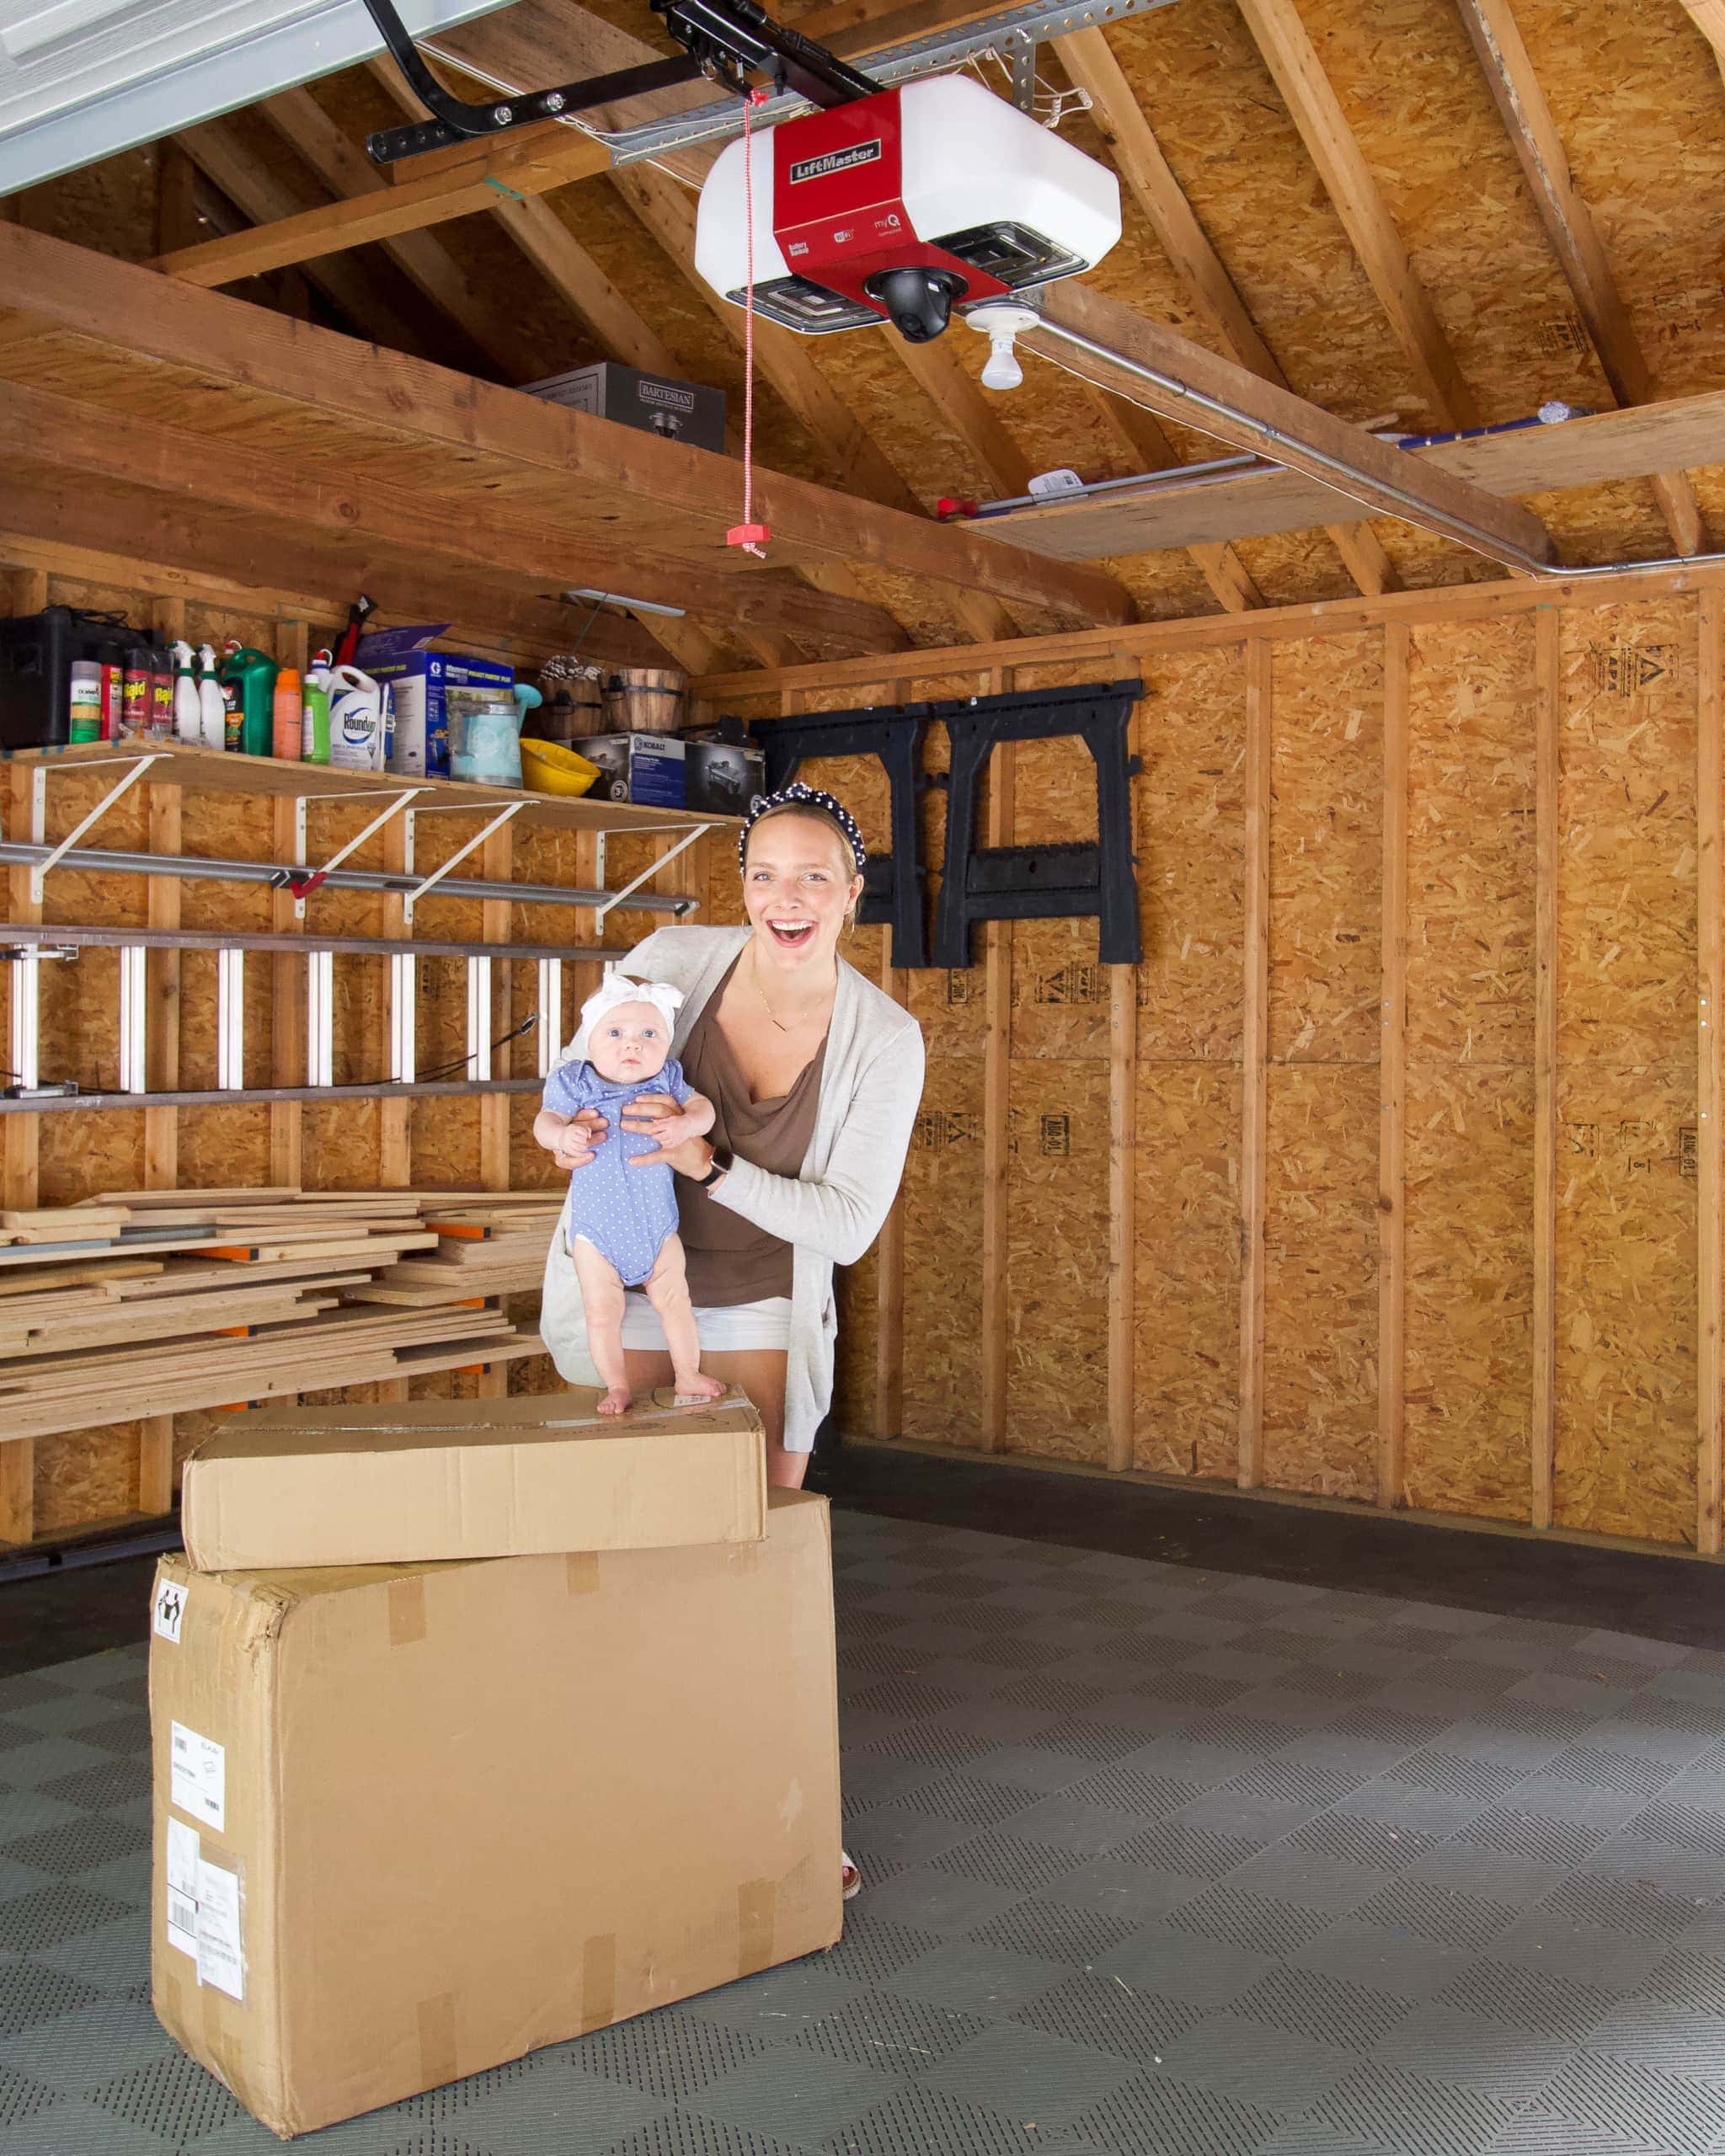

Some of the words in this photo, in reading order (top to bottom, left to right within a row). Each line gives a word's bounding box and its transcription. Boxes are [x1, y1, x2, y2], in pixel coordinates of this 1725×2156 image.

[796, 147, 874, 178] LiftMaster
[874, 214, 900, 229] myQ
[641, 385, 692, 405] BARTESIAN
[1608, 657, 1618, 691] APA
[344, 712, 377, 734] Roundup
[644, 741, 665, 751] KOBALT
[1079, 967, 1089, 998] APA
